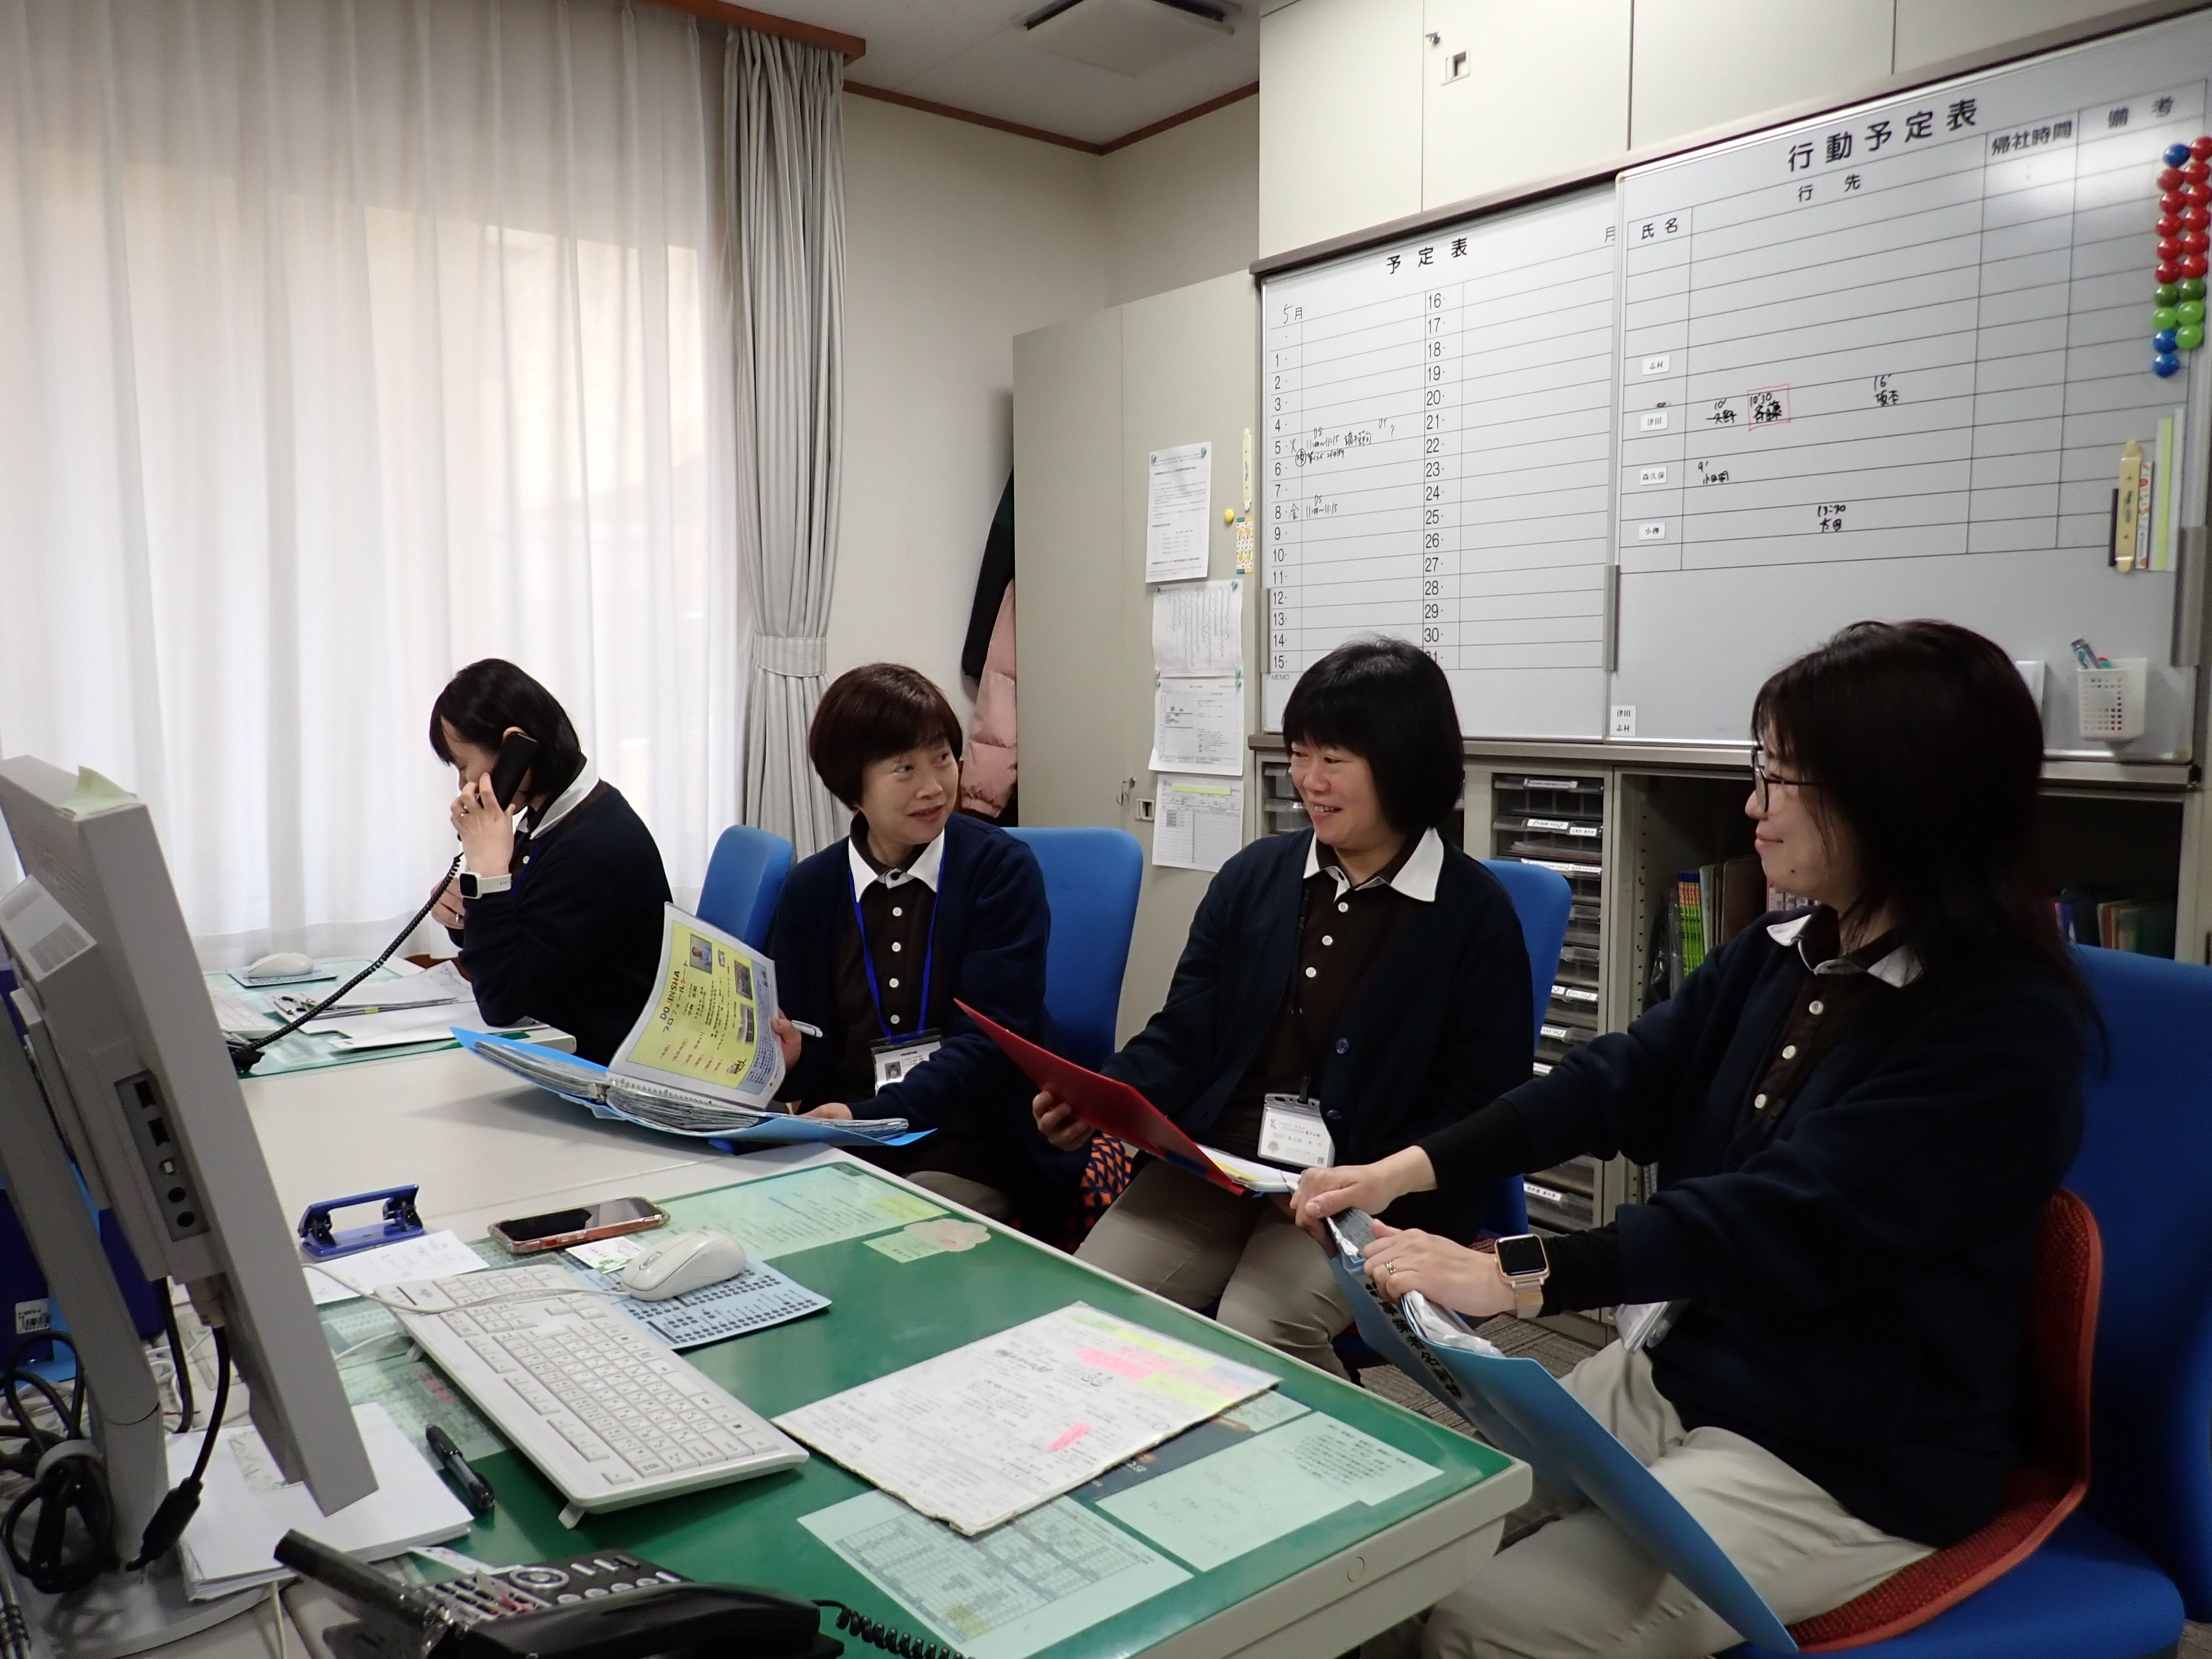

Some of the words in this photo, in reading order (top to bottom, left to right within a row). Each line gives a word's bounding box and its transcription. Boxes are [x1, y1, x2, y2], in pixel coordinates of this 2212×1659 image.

[2109, 97, 2173, 128] 備考
[1788, 97, 1977, 172] 行動予定表
[1992, 121, 2072, 155] 帰社時間
[1798, 174, 1861, 203] 行先
[1641, 217, 1678, 240] 氏名
[1386, 238, 1468, 275] 予定表
[1427, 292, 1442, 310] 16
[1428, 317, 1441, 335] 17
[1428, 341, 1441, 358] 18
[1275, 353, 1279, 368] 1
[1427, 365, 1441, 382] 19
[1275, 375, 1281, 390] 2
[1274, 397, 1281, 411] 3
[1426, 389, 1441, 406] 20
[1275, 418, 1281, 432] 4
[1426, 413, 1439, 430] 21
[1275, 440, 1281, 455] 5
[1426, 437, 1440, 455] 22
[1275, 462, 1281, 476] 6
[1425, 461, 1441, 478] 23
[1642, 471, 1664, 481] 森久保
[1275, 483, 1281, 498] 7
[1425, 484, 1440, 502] 24
[1275, 505, 1281, 520] 8
[1425, 509, 1439, 525] 25
[1274, 526, 1281, 541] 9
[1425, 533, 1439, 549] 26
[1273, 548, 1285, 562] 10
[1425, 557, 1439, 572] 27
[1273, 570, 1283, 585] 11
[1425, 580, 1439, 596] 28
[1273, 591, 1284, 605] 12
[1274, 612, 1285, 626] 13
[1425, 603, 1439, 619] 29
[1274, 633, 1285, 647] 14
[1424, 627, 1439, 643] 30
[1274, 655, 1285, 669] 15
[660, 970, 681, 1020] DOJINSHA
